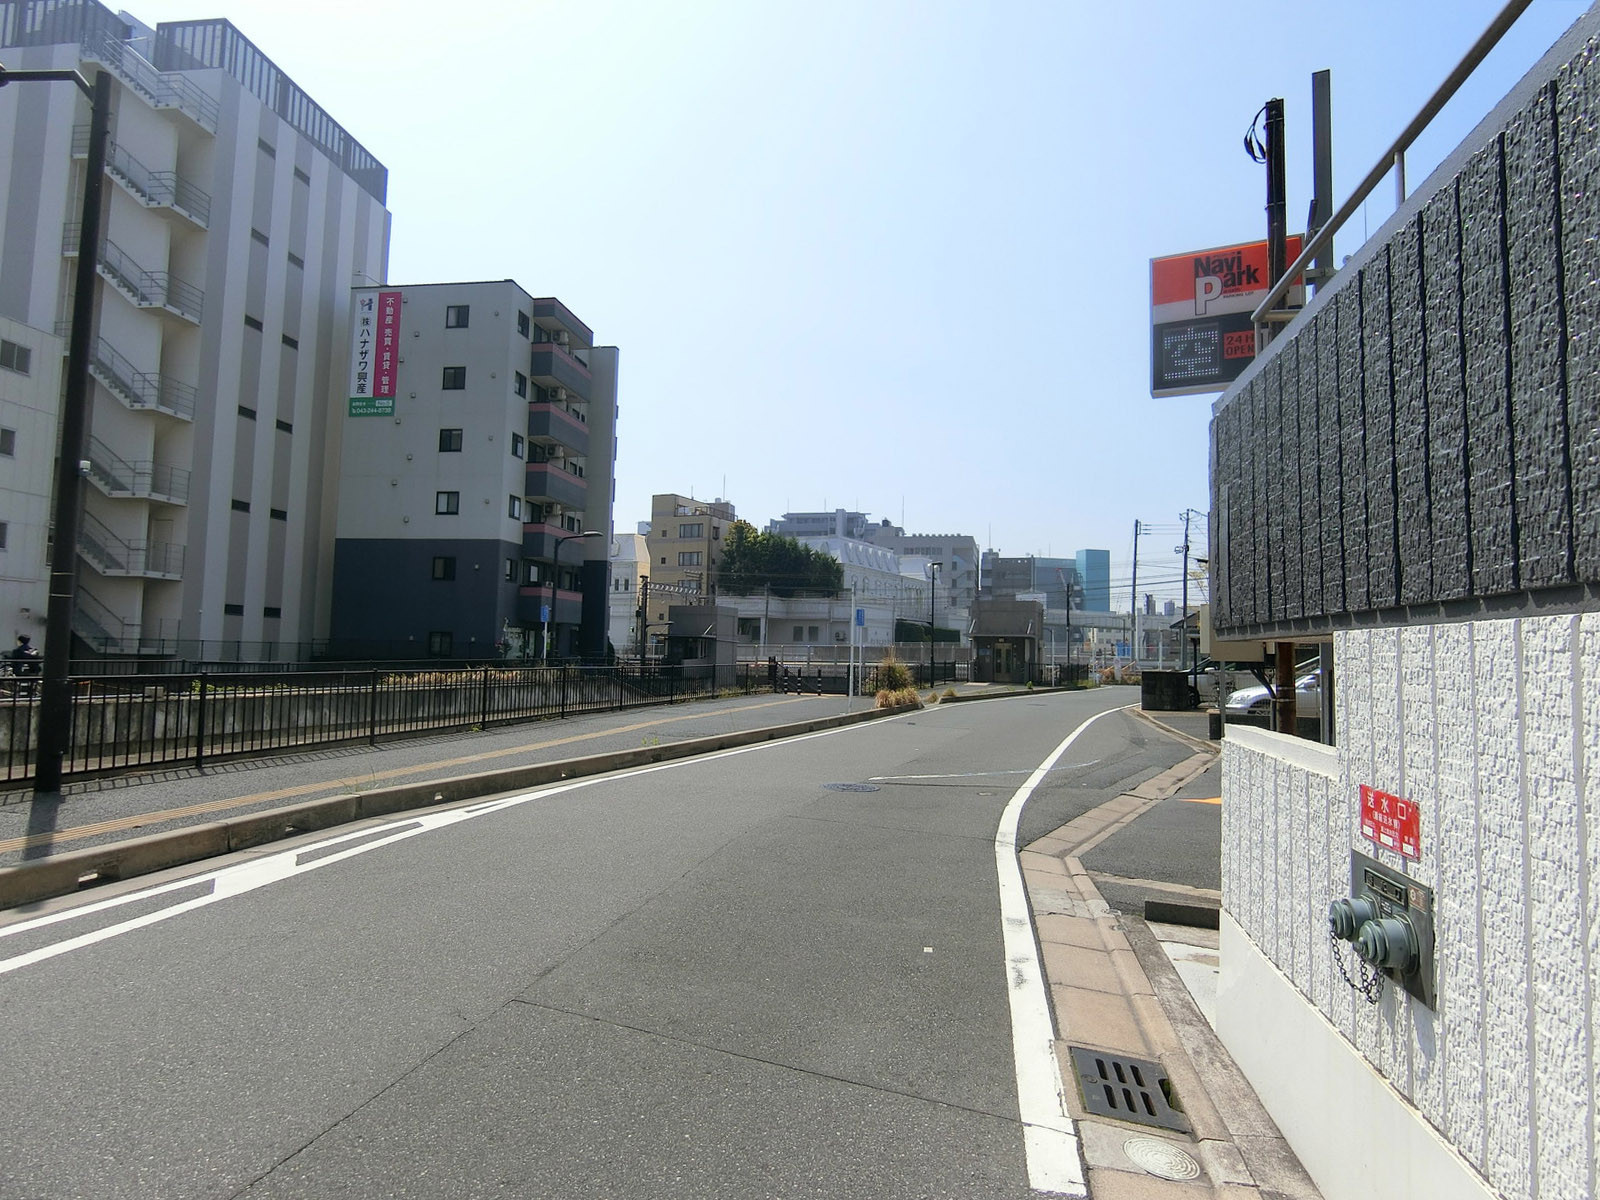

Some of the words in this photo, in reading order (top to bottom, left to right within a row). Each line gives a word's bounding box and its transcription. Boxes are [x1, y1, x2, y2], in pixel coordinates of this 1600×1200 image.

[1194, 250, 1242, 277] Navi
[1194, 264, 1260, 316] Park
[384, 297, 395, 325] 不動産
[1226, 344, 1255, 355] OPEN
